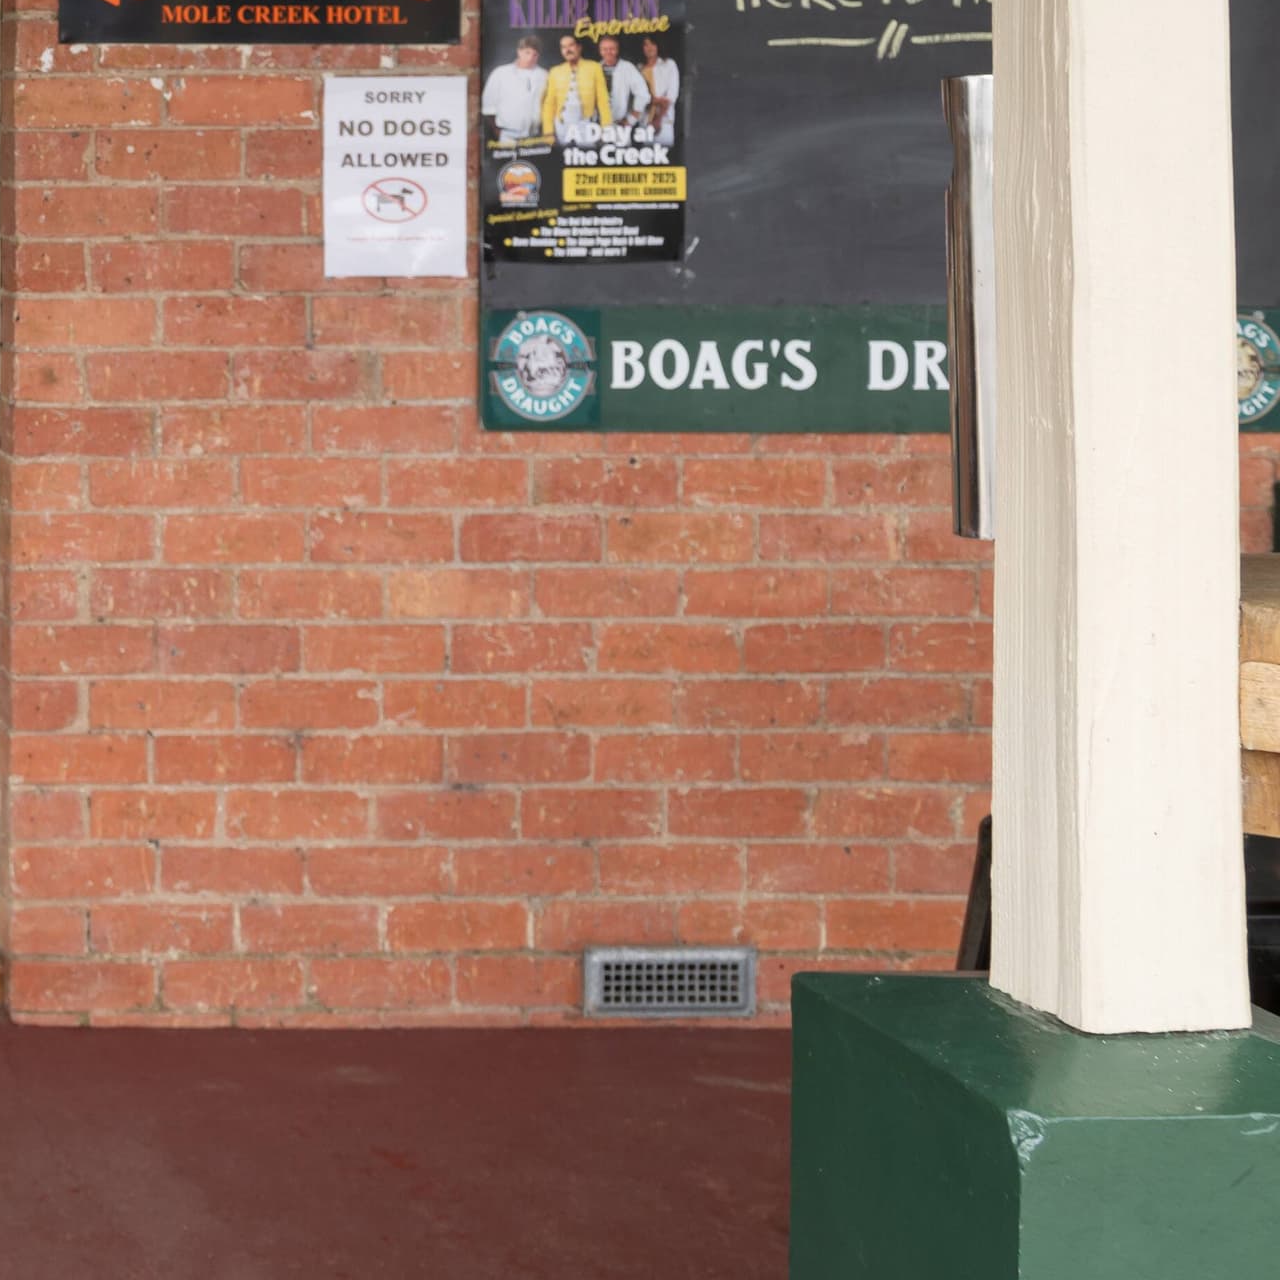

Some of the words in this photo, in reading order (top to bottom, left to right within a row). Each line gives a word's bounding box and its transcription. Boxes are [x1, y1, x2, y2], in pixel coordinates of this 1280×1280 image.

[162, 5, 231, 25] MOLE
[237, 5, 320, 25] CREEK
[328, 5, 408, 25] HOTEL
[574, 14, 670, 42] Experience
[365, 91, 426, 104] SORRY
[339, 120, 373, 136] NO
[384, 120, 452, 136] DOGS
[587, 122, 632, 147] Day
[634, 123, 655, 143] at
[341, 153, 449, 168] ALLOWED
[563, 147, 597, 165] the
[600, 143, 670, 165] Creek
[610, 338, 818, 392] BOAG'S
[502, 377, 582, 415] DRAUGHT
